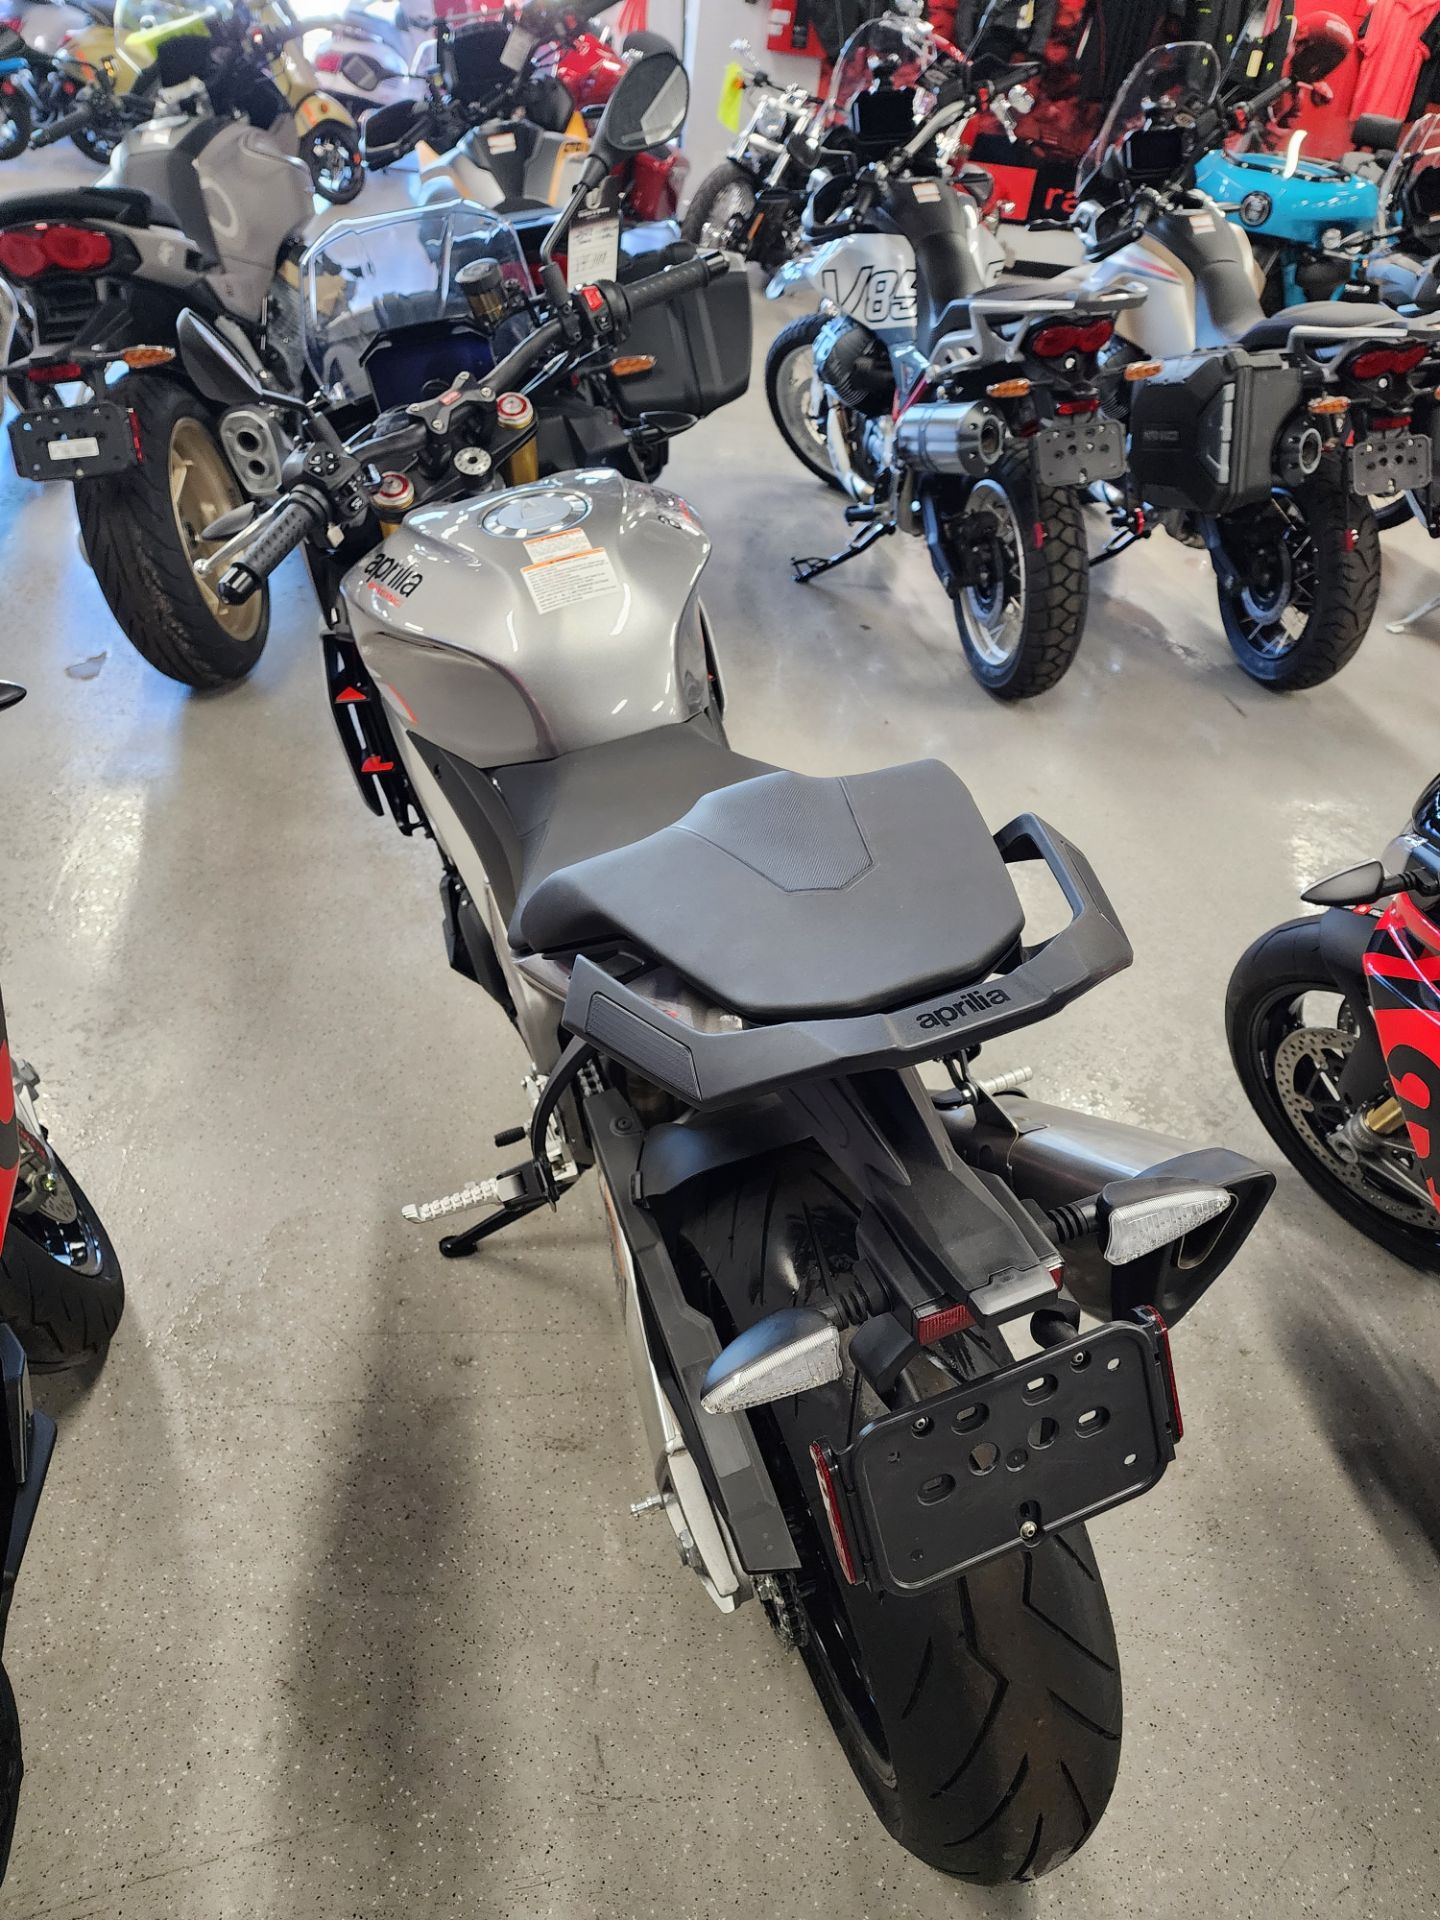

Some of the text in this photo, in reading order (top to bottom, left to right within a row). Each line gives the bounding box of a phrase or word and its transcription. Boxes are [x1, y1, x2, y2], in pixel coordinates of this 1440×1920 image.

[822, 265, 918, 323] V85
[364, 553, 423, 598] aprilia
[916, 988, 1012, 1029] aprilia
